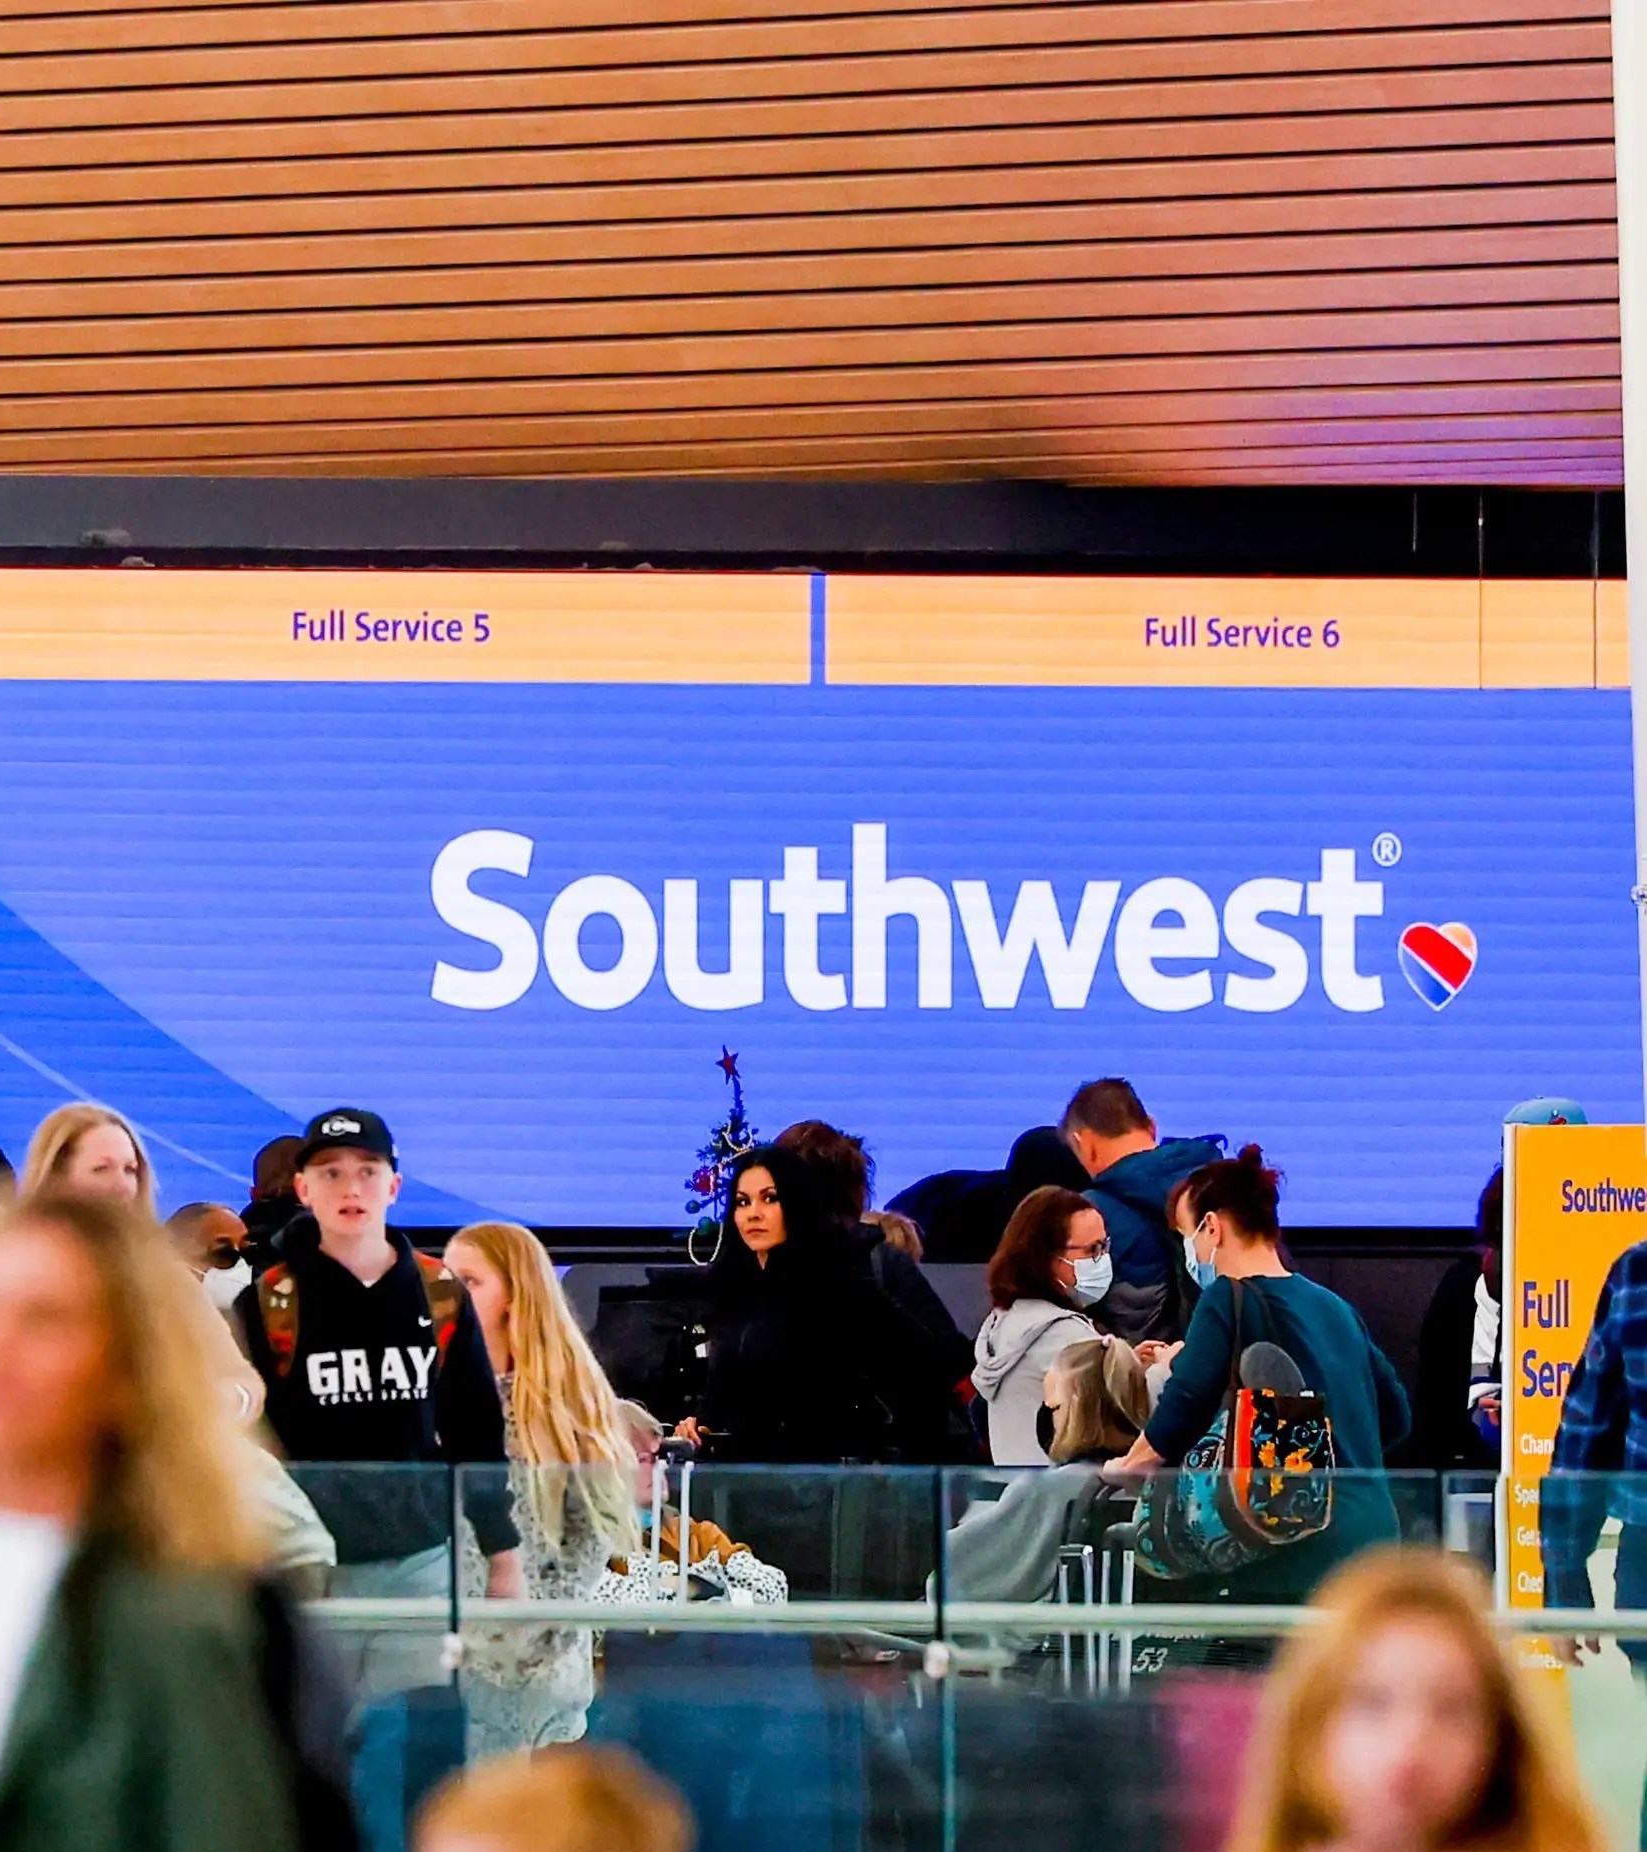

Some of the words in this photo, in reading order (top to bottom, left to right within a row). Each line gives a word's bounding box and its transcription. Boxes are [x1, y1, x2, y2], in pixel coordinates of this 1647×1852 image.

[292, 609, 345, 642] Full
[354, 611, 463, 642] Service
[473, 613, 490, 643] 5
[1144, 615, 1196, 647] Full
[1206, 617, 1312, 649] Service
[1322, 619, 1340, 648] 6
[1561, 1178, 1647, 1213] Southwe
[1522, 1279, 1570, 1329] Full
[306, 1345, 439, 1397] GRAY
[1519, 1434, 1555, 1455] Chan
[1132, 1647, 1168, 1673] 53
